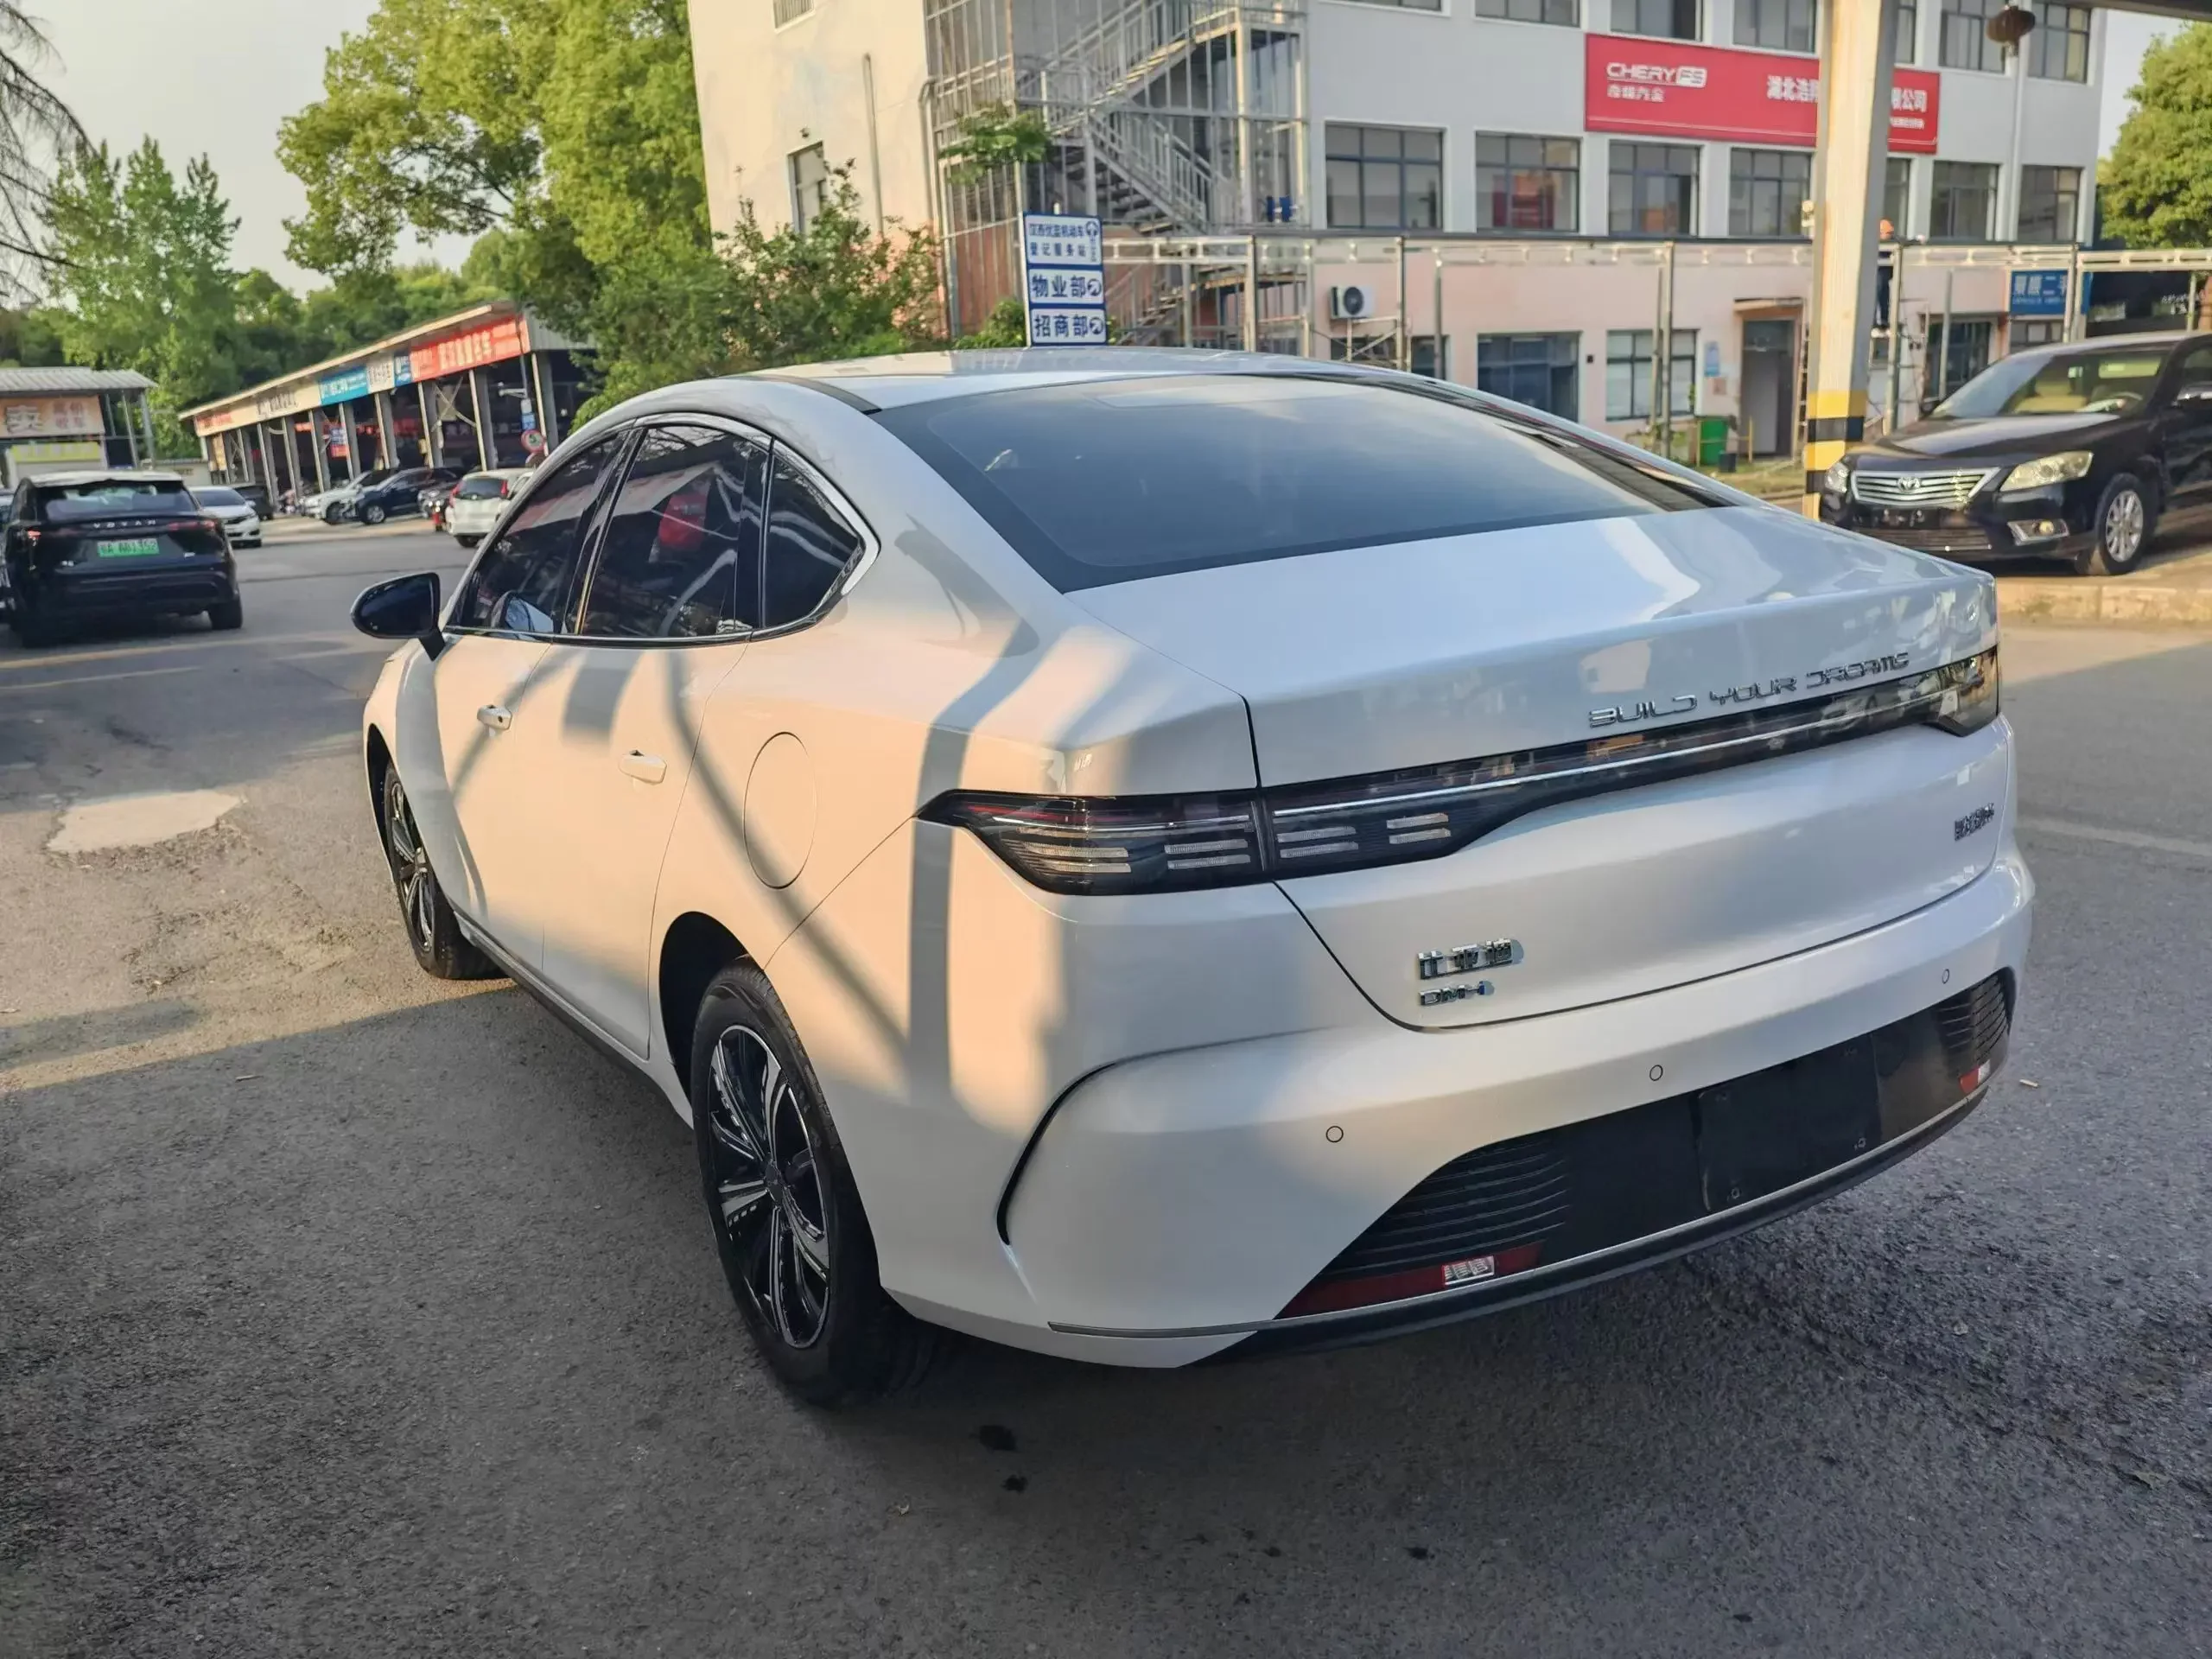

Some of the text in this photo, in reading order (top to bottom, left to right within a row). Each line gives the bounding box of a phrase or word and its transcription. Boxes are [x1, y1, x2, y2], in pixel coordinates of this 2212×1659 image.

[1606, 62, 1676, 84] CHERY
[1032, 273, 1086, 297] 物业部
[1034, 314, 1089, 338] 招商部
[1588, 652, 1910, 728] BUILD YOUR DREAMS
